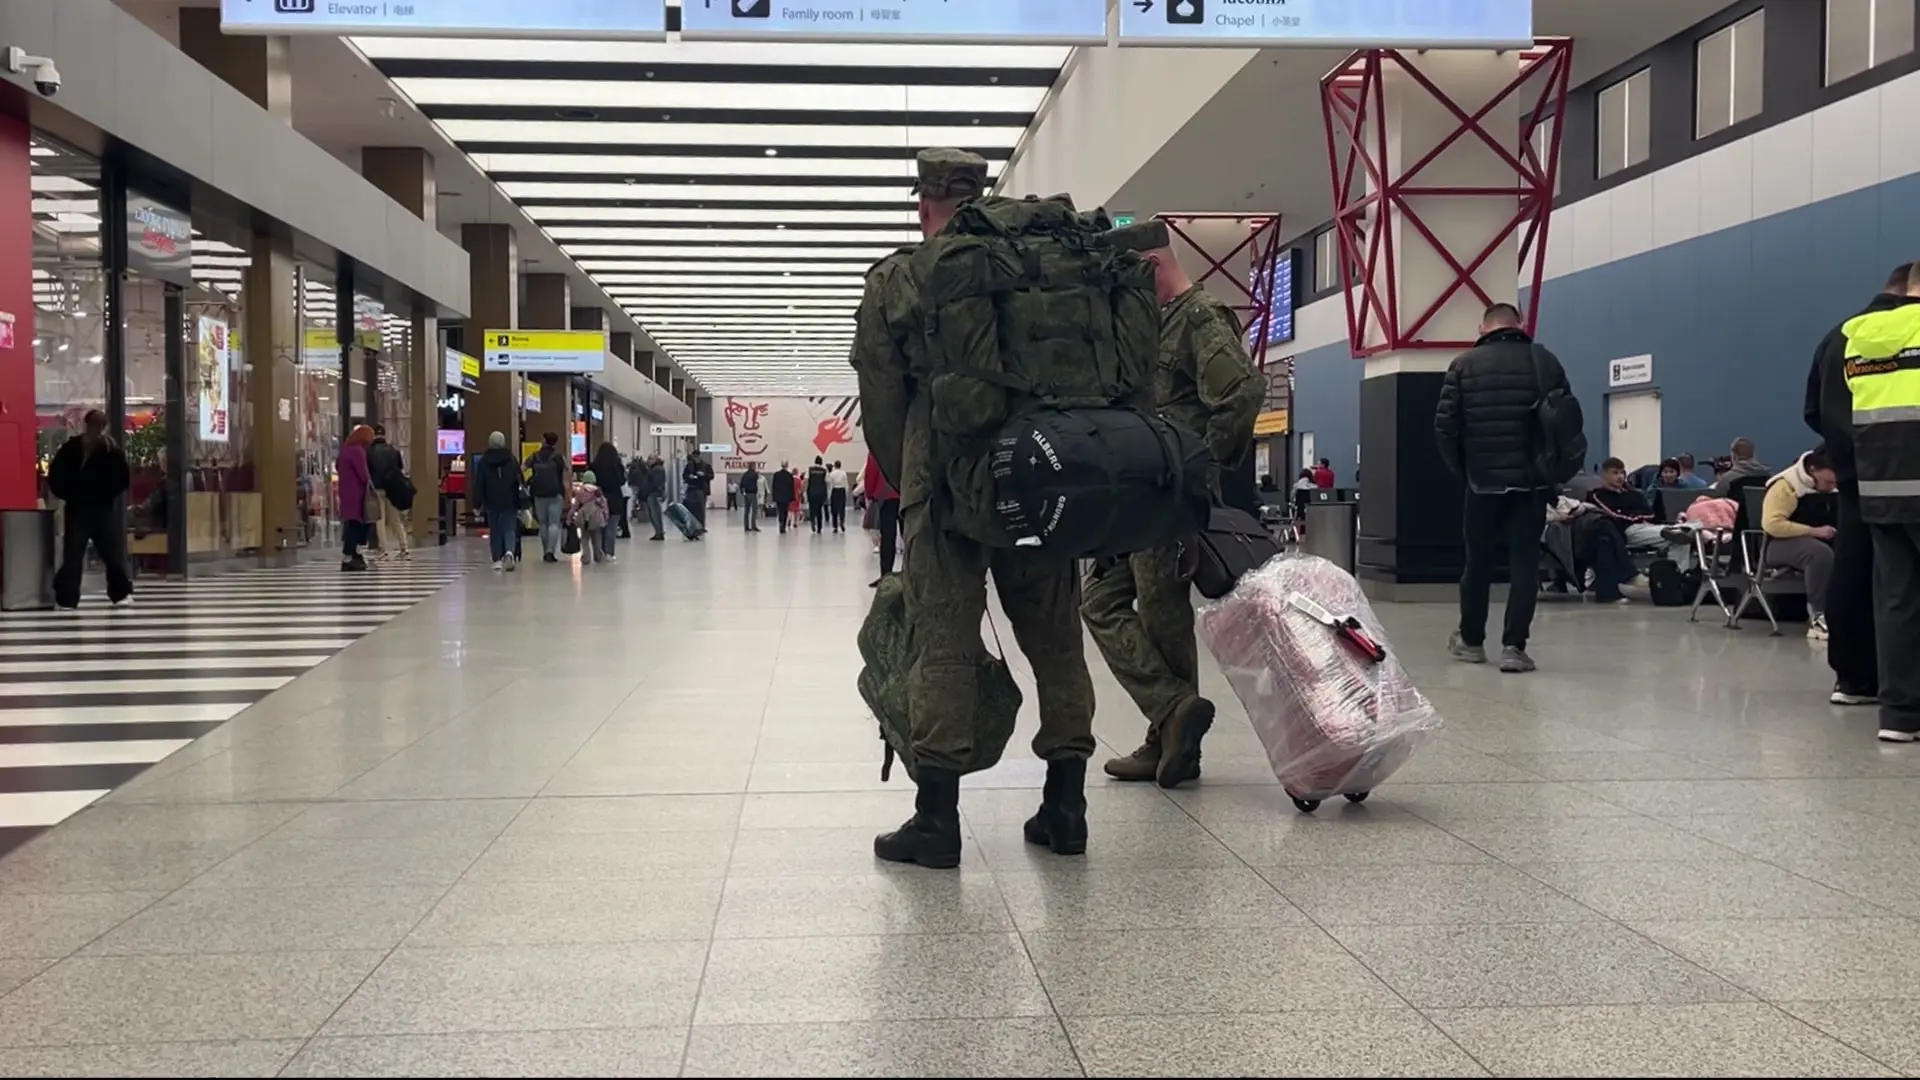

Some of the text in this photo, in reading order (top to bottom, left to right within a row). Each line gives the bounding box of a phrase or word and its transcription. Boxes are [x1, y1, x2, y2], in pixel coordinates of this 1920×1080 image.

[328, 2, 377, 15] Elevator
[782, 7, 854, 22] Family room
[1215, 14, 1255, 28] Chapel
[1031, 429, 1062, 471] TALBERG
